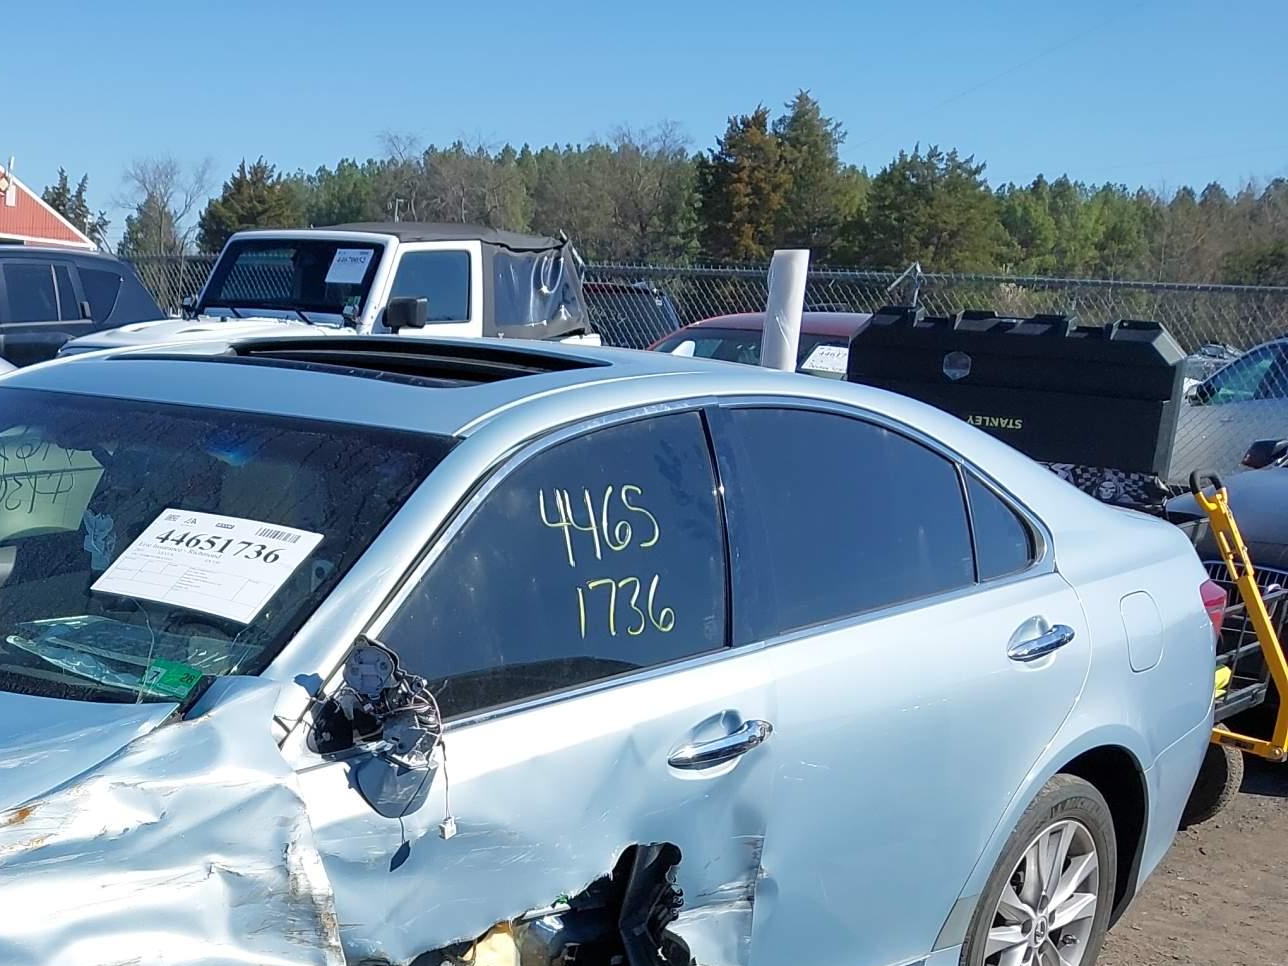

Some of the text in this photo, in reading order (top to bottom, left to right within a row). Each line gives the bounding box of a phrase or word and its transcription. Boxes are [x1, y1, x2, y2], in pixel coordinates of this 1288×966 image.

[967, 415, 1023, 430] STANLEY
[155, 529, 288, 563] 44651736
[539, 485, 660, 568] 4465
[575, 574, 675, 639] 1736
